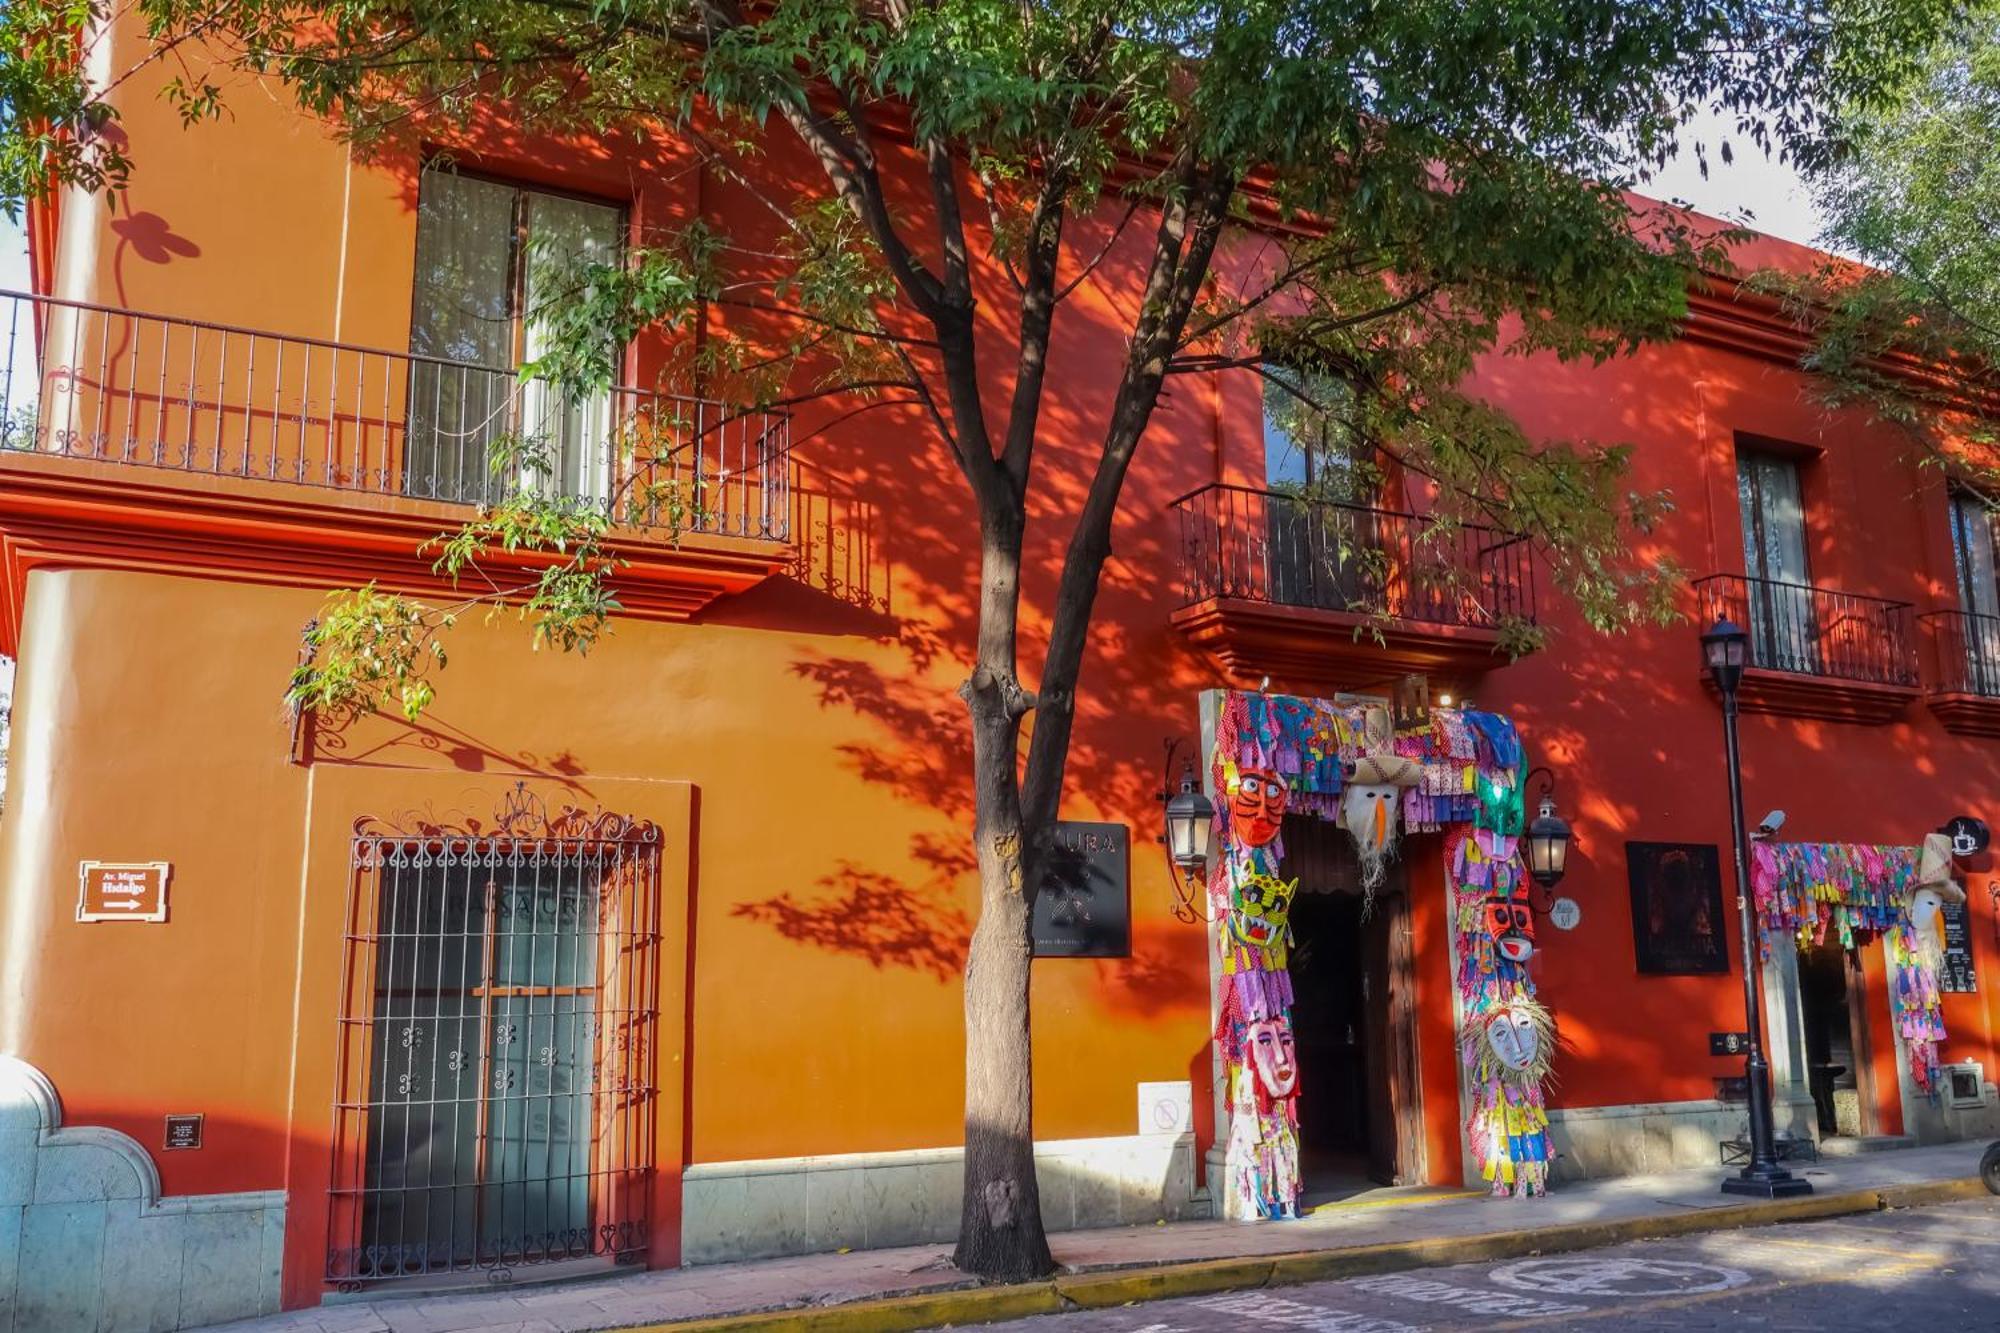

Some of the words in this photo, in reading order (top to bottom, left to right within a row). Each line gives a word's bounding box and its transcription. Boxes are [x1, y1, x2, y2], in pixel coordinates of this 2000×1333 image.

[103, 872, 117, 881] Av.
[118, 872, 146, 882] Miguel
[102, 882, 146, 895] Hidalgo
